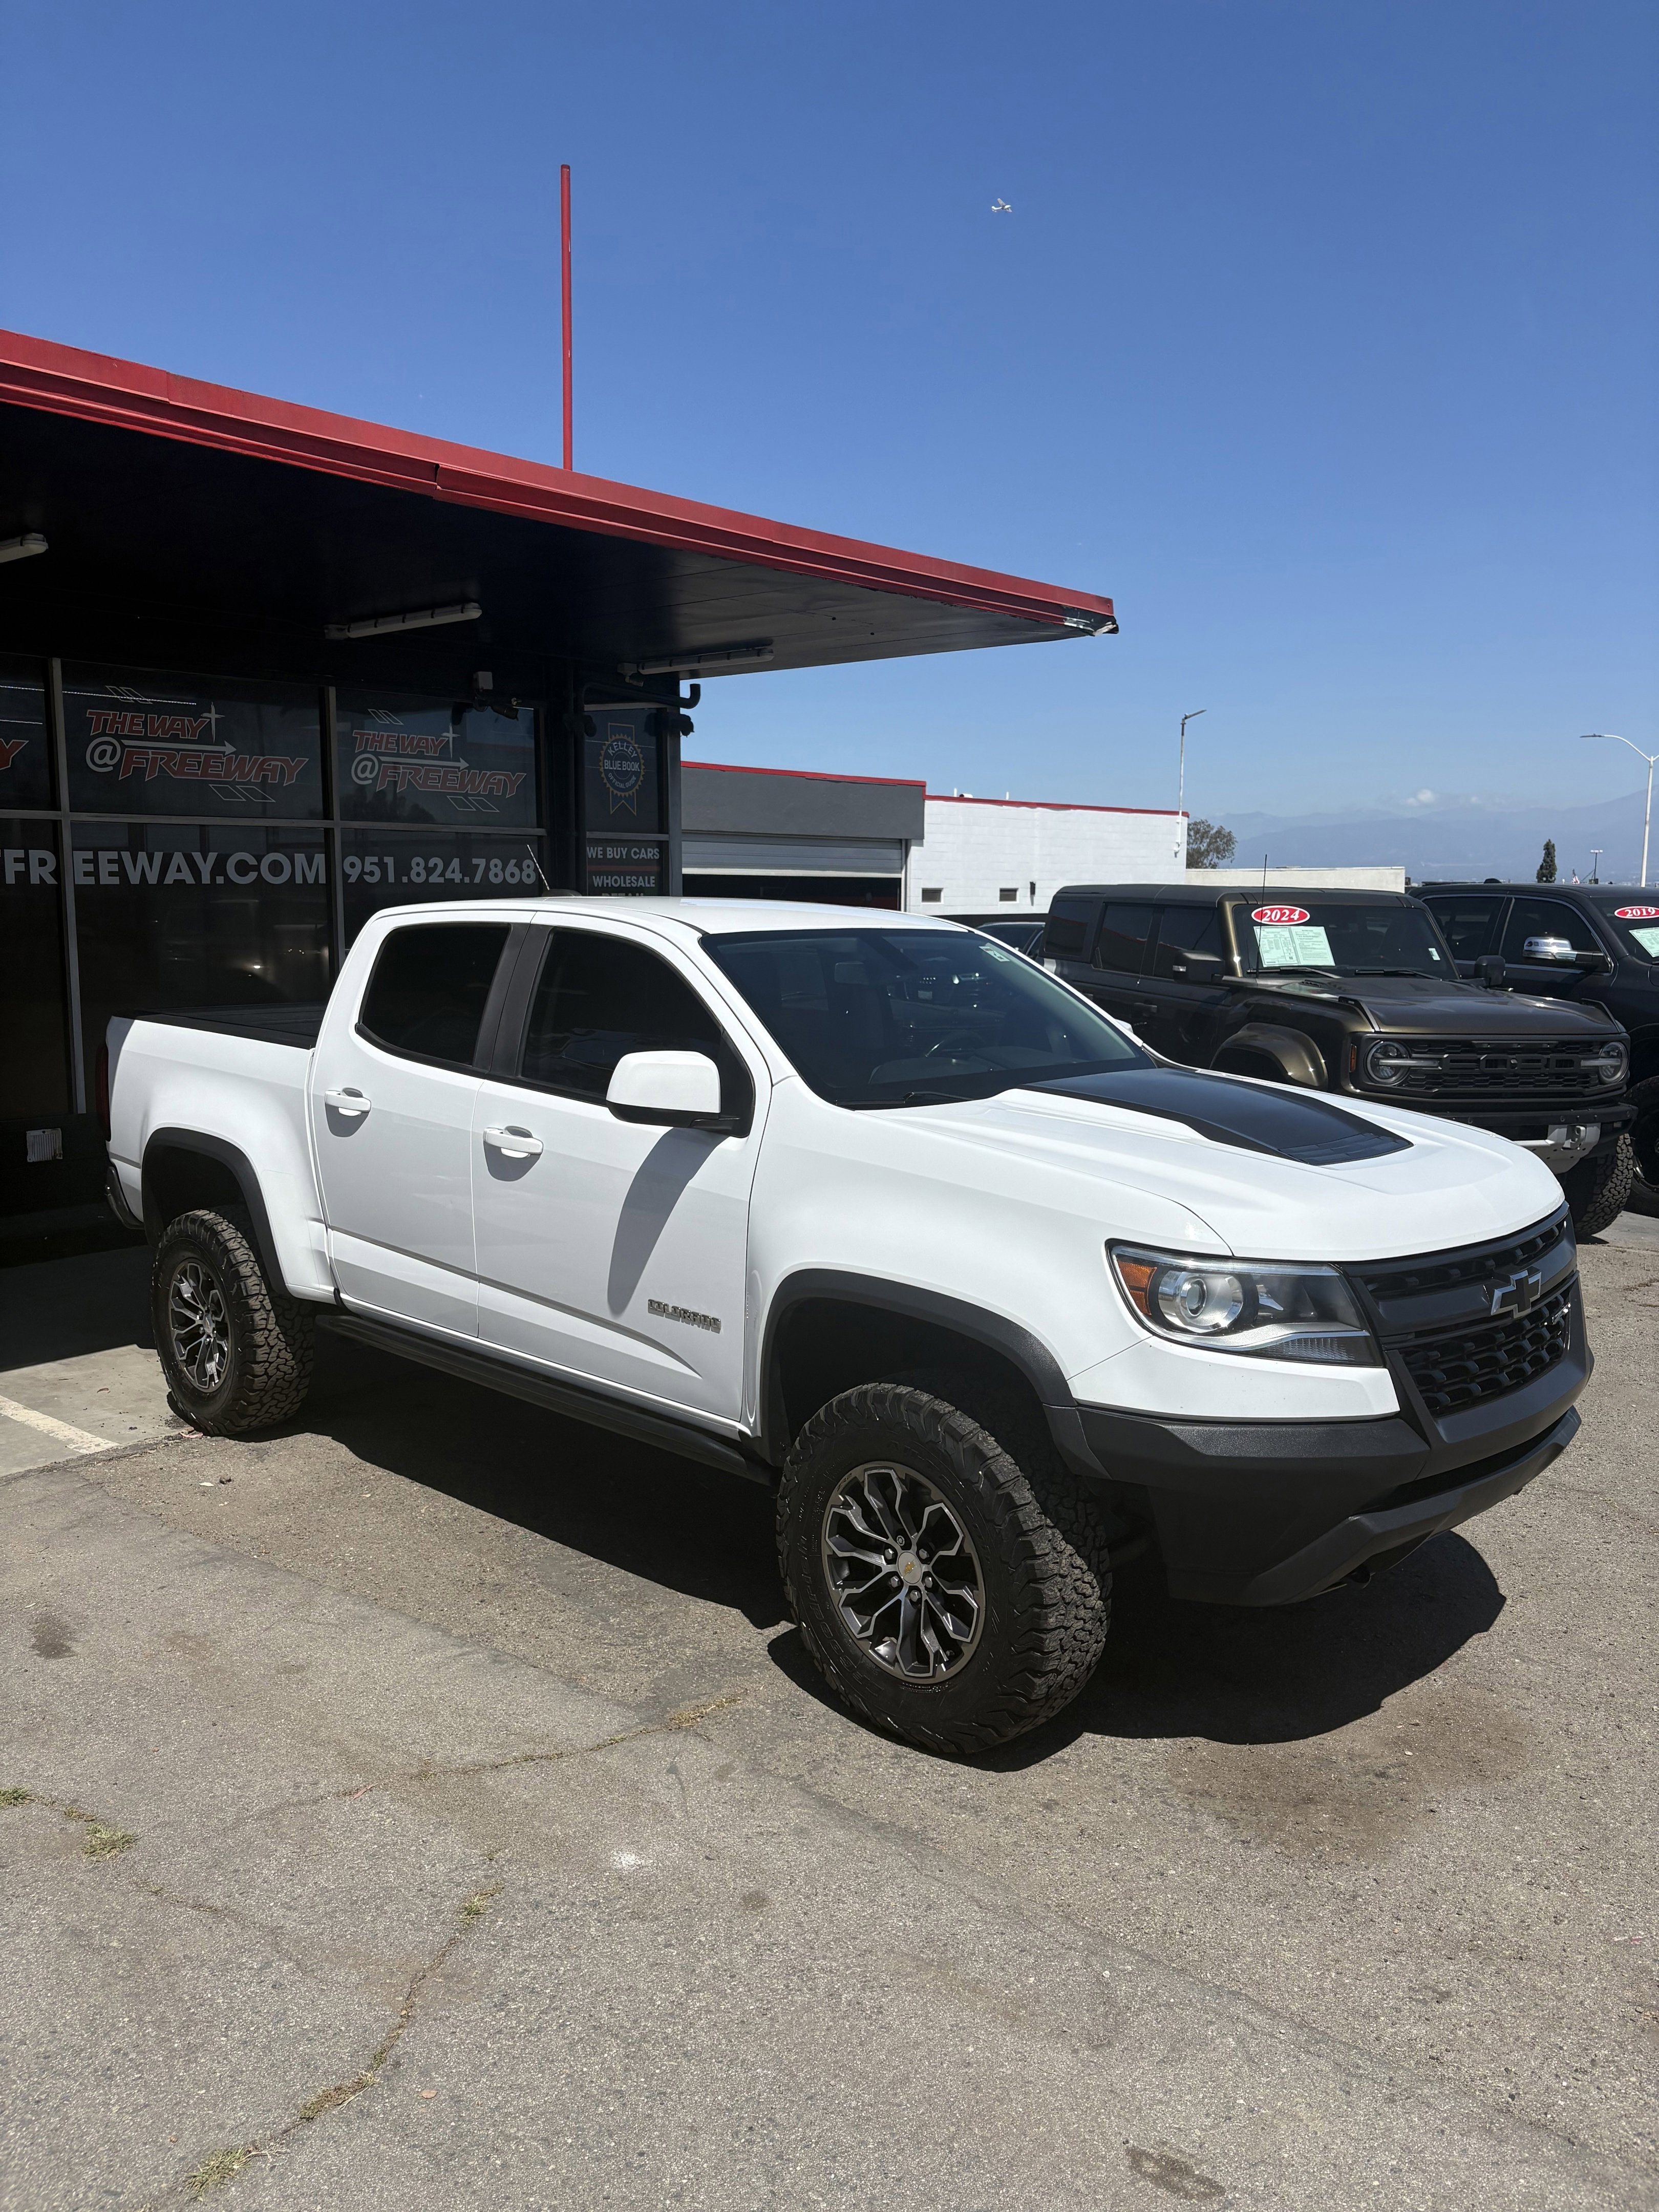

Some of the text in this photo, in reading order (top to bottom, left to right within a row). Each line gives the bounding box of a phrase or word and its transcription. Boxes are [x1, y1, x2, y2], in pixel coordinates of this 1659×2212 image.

[608, 741, 637, 757] KELLEY
[604, 760, 640, 771] BLUE BOOK
[608, 773, 636, 789] OFFICIAL GUIDE
[587, 846, 660, 860] WE BUY CARS
[343, 856, 536, 884] 951.824.7868
[592, 876, 655, 887] WHOLESALE
[1262, 909, 1300, 921] 2024
[1624, 908, 1655, 917] 2019
[1442, 1054, 1581, 1074] FORD
